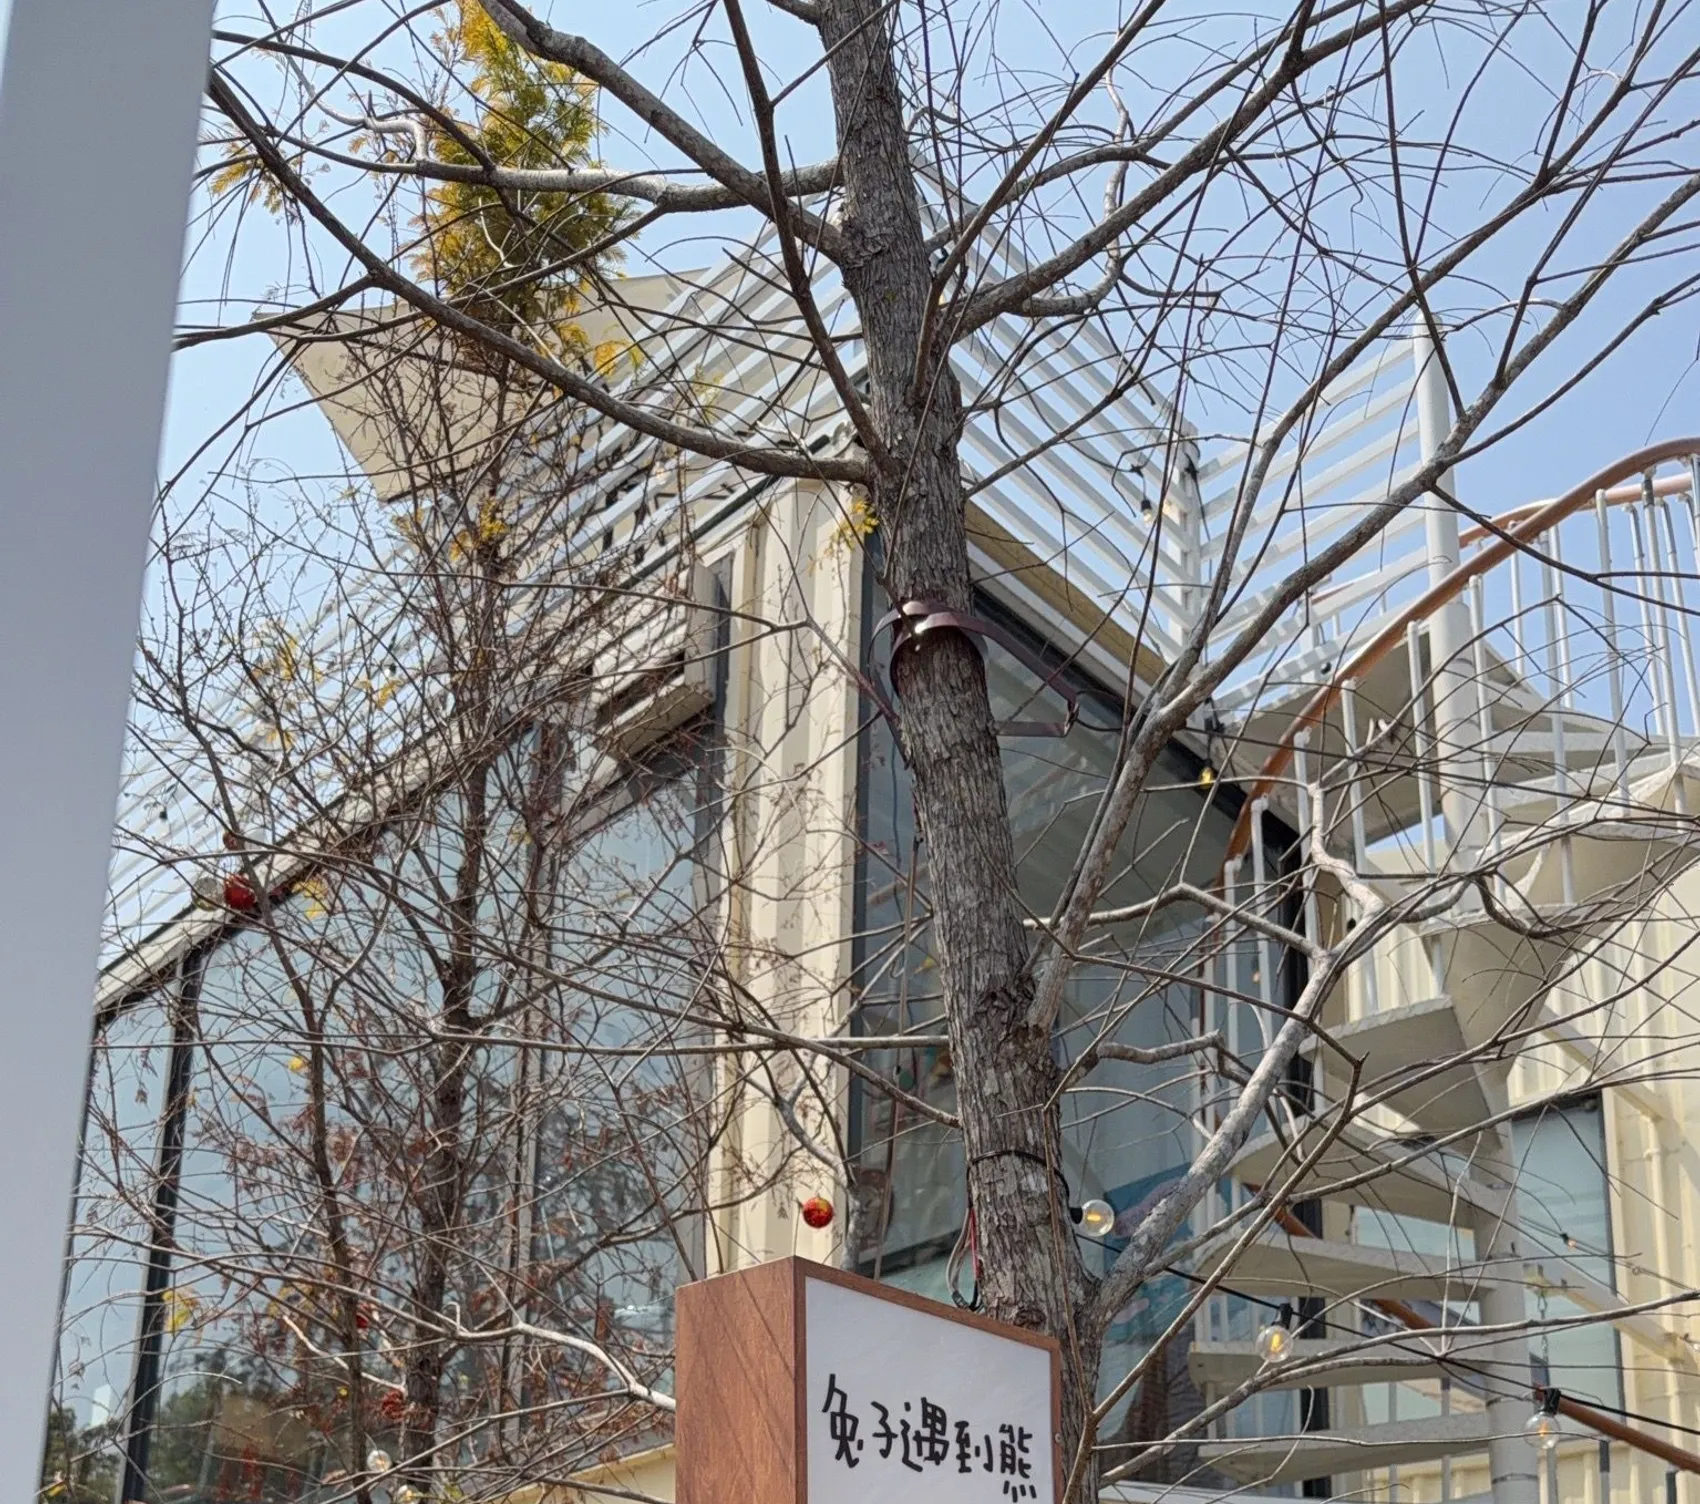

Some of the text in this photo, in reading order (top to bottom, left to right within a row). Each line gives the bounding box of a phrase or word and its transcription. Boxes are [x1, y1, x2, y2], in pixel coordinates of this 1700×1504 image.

[822, 1373, 1037, 1503] 兔子遇到熊
